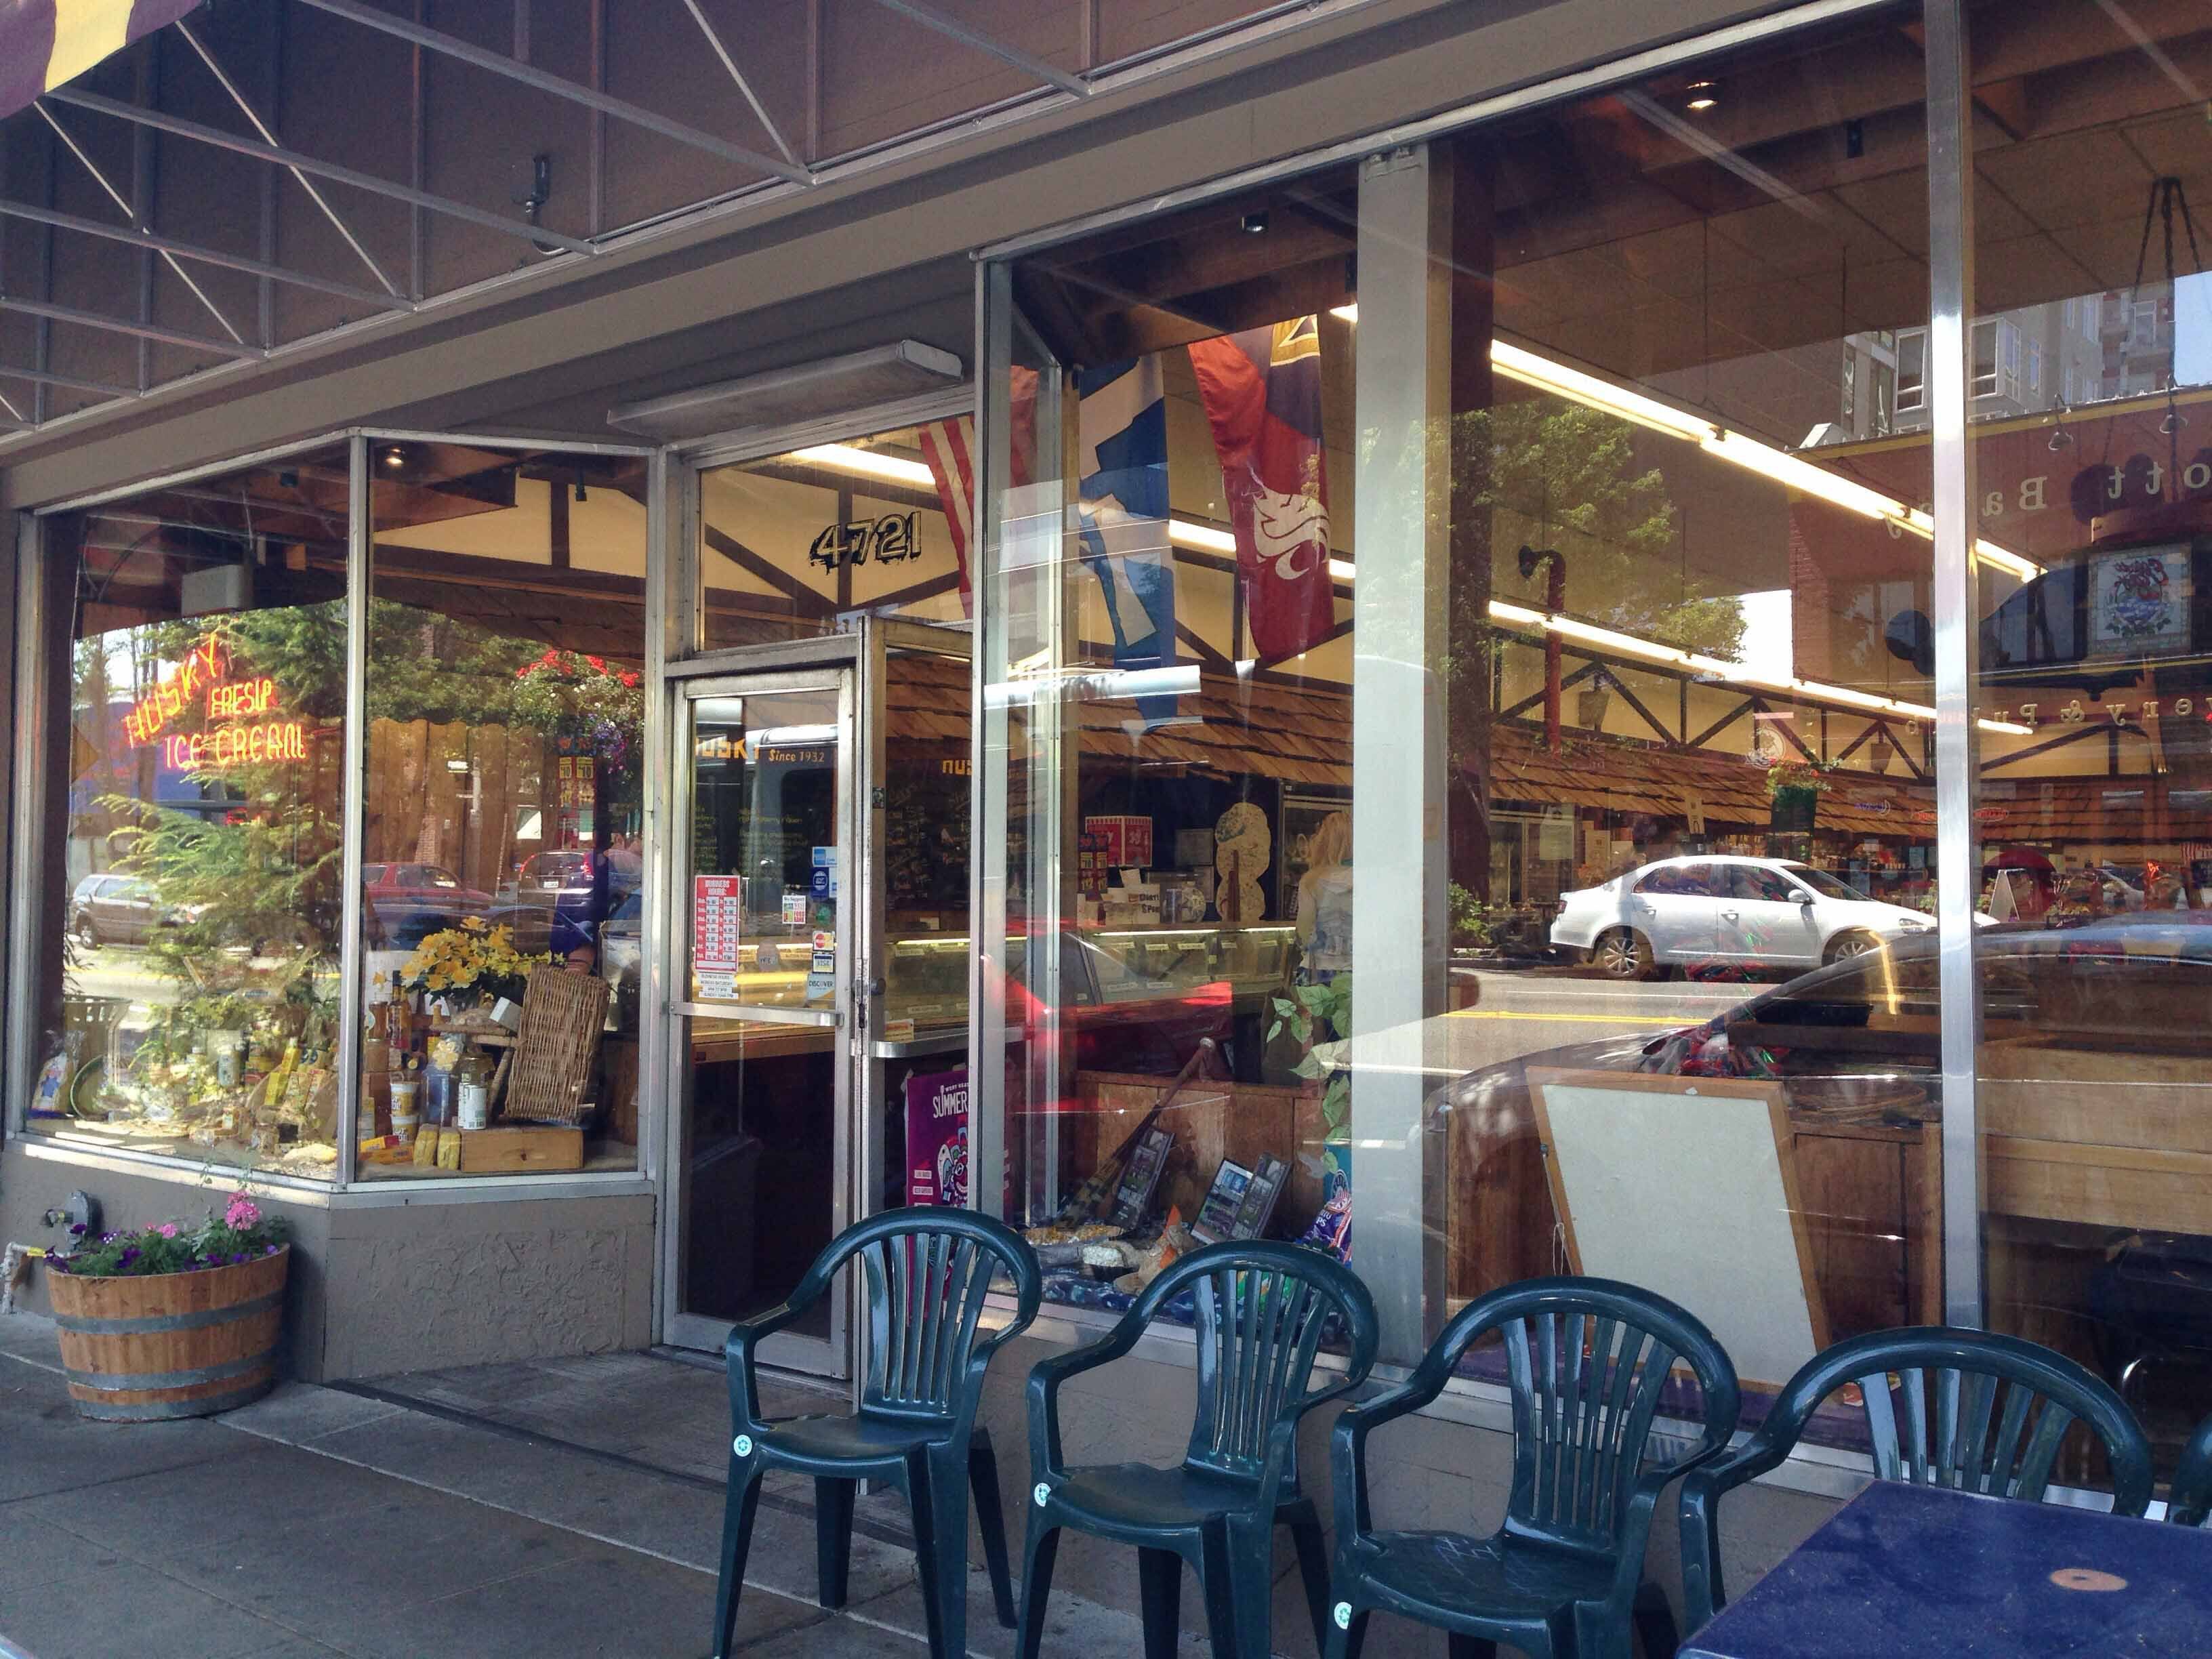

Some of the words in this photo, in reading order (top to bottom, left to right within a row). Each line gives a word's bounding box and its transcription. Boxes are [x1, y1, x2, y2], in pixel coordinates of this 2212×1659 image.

[809, 510, 922, 573] 4721
[125, 633, 218, 749] HUSKY
[165, 733, 203, 770] ICE
[216, 722, 306, 765] CREAM
[769, 748, 796, 762] Since
[799, 748, 825, 762] 1932
[933, 1087, 968, 1118] SUMMER
